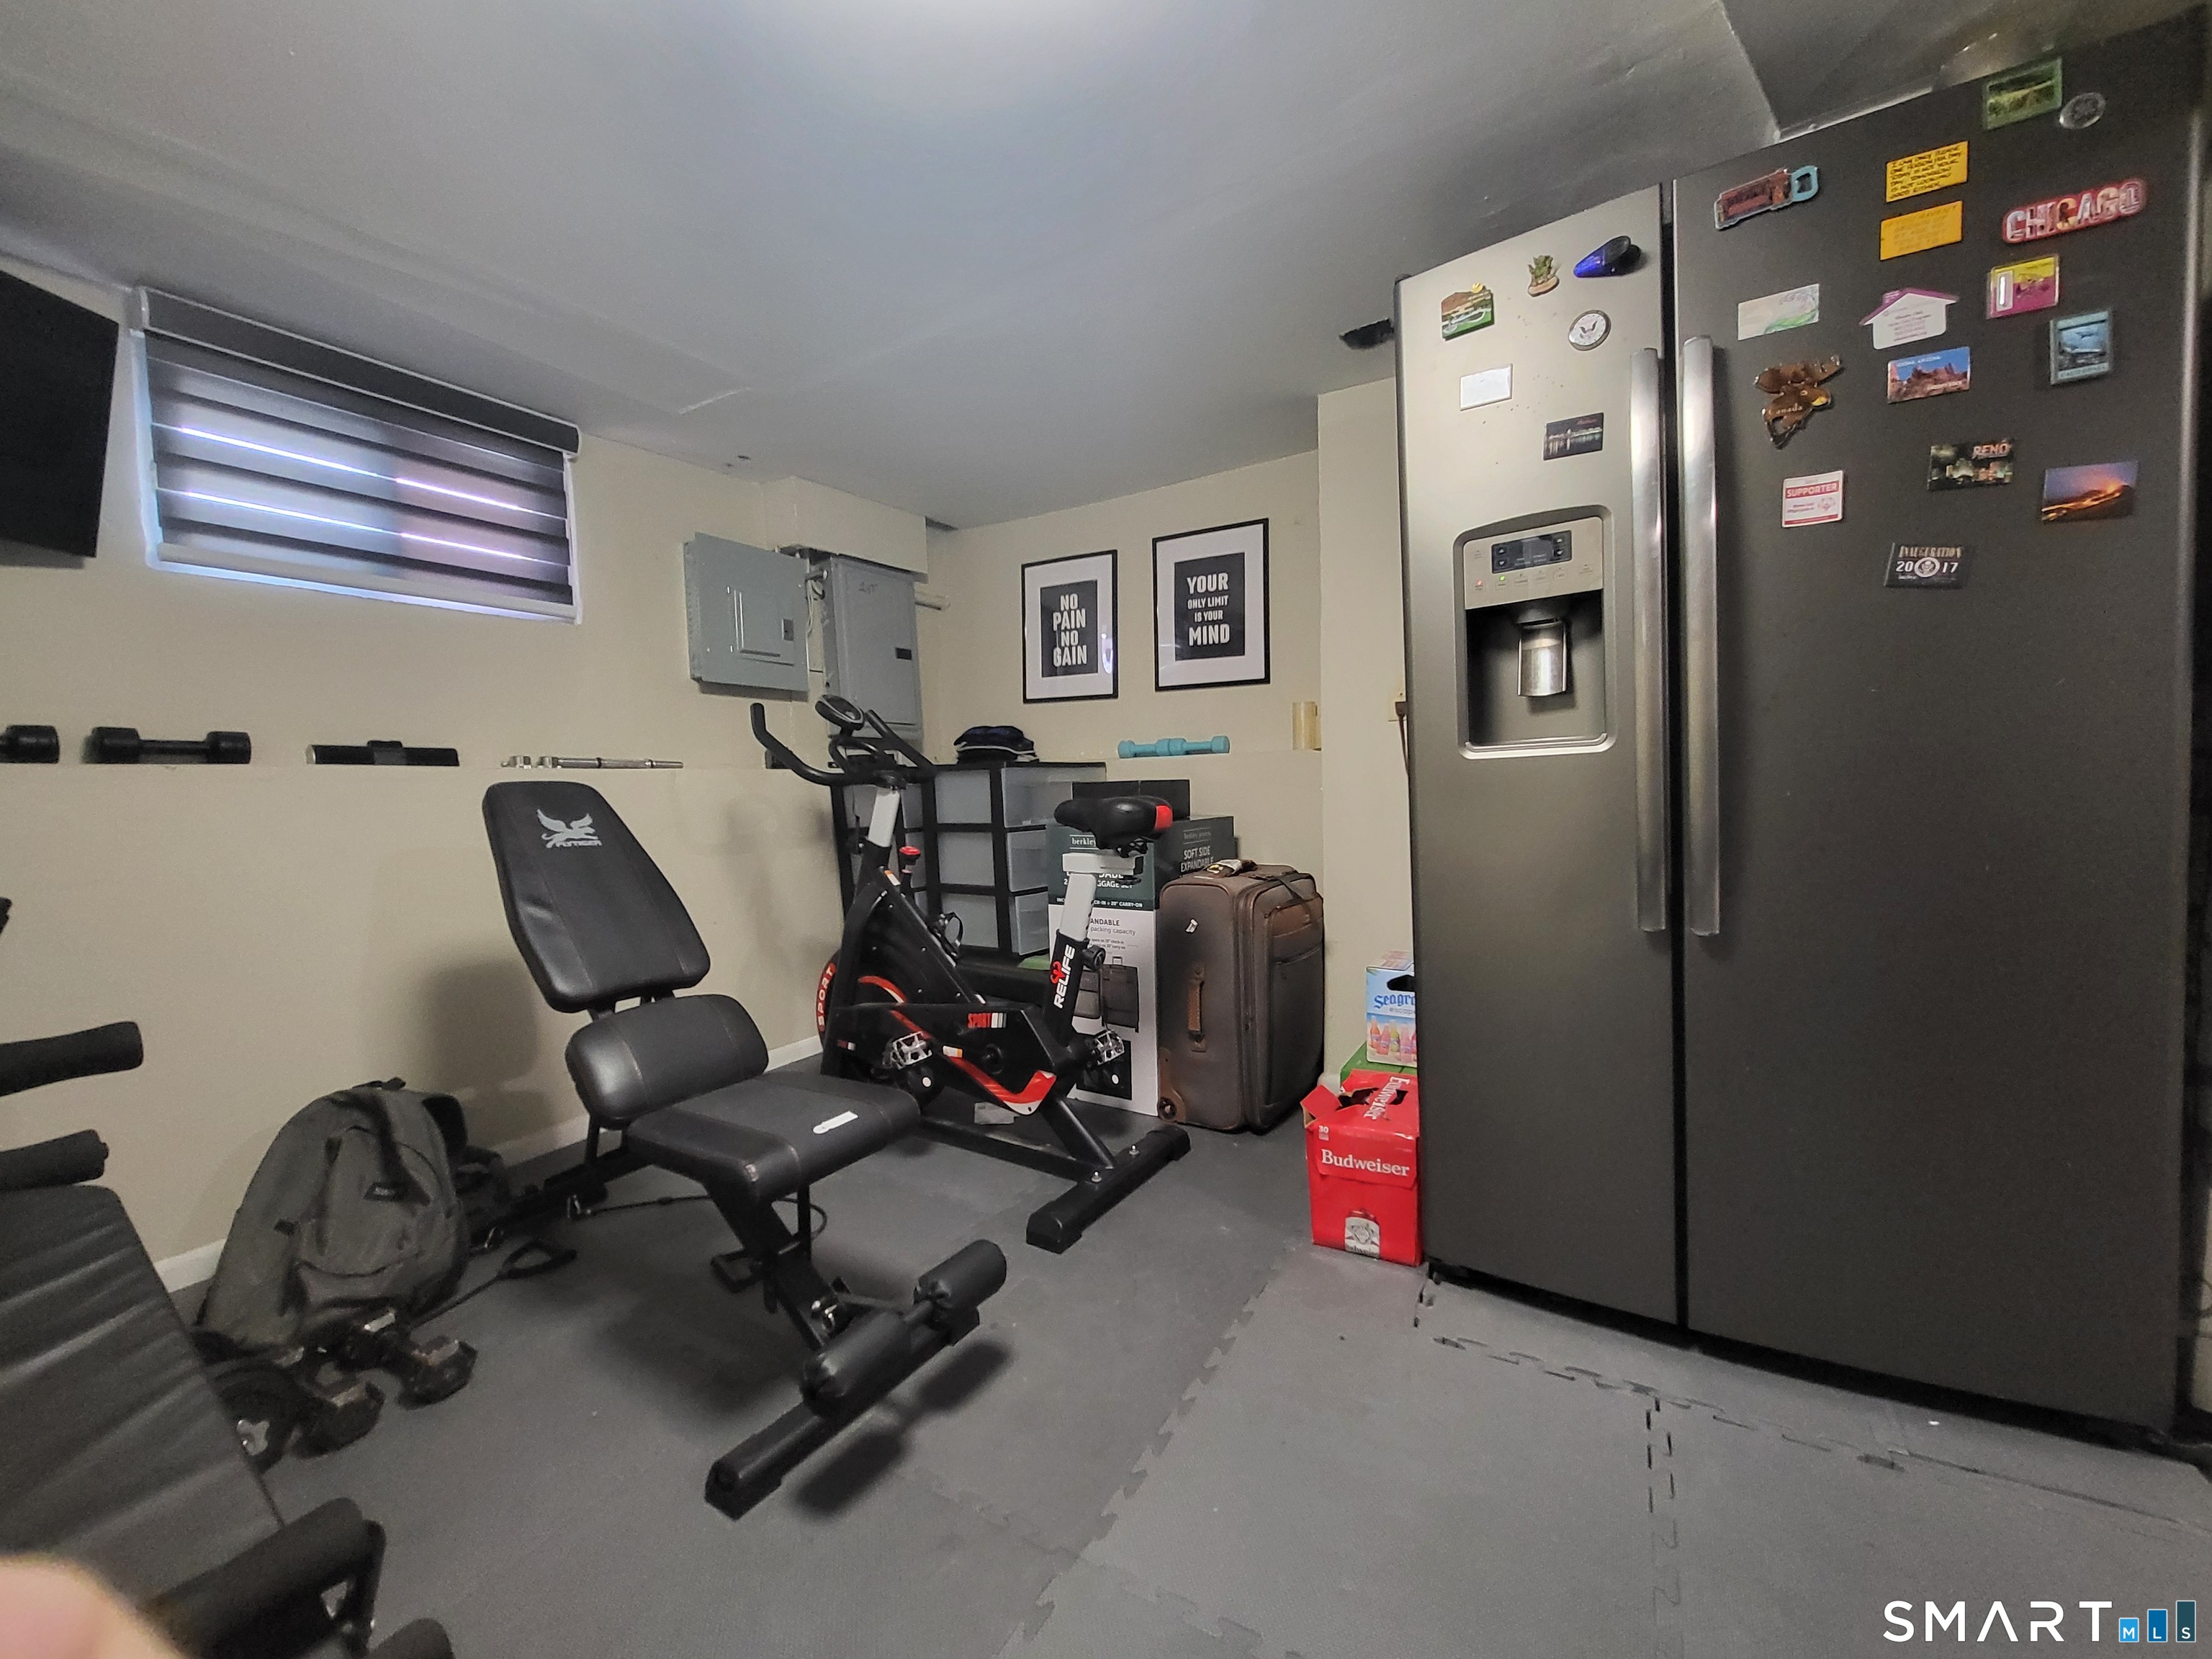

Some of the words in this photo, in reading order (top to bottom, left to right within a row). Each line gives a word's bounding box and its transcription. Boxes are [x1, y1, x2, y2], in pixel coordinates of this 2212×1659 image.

[2006, 181, 2141, 241] CHICAGO
[1972, 442, 2011, 459] RENO
[1787, 482, 1838, 498] SUPPORTER
[1896, 561, 1914, 572] 20
[1942, 562, 1959, 573] 17
[1187, 572, 1228, 595] YOUR
[1060, 593, 1078, 611] NO
[1187, 597, 1207, 610] ONLY
[1208, 595, 1228, 607] LIMIT
[1053, 608, 1086, 631] PAIN
[1195, 612, 1202, 623] IS
[1203, 609, 1223, 622] YOUR
[1061, 629, 1079, 647] NO
[1189, 624, 1231, 647] MIND
[1053, 645, 1087, 667] GAIN
[1184, 848, 1198, 860] SOFT
[1199, 845, 1211, 857] SIDE
[1089, 918, 1120, 927] ANDABLE
[1090, 926, 1112, 935] packing
[1112, 927, 1136, 936] capacity
[1053, 944, 1075, 1009] RELIFE
[1318, 1125, 1329, 1133] 30
[1321, 1148, 1411, 1177] Budweiser
